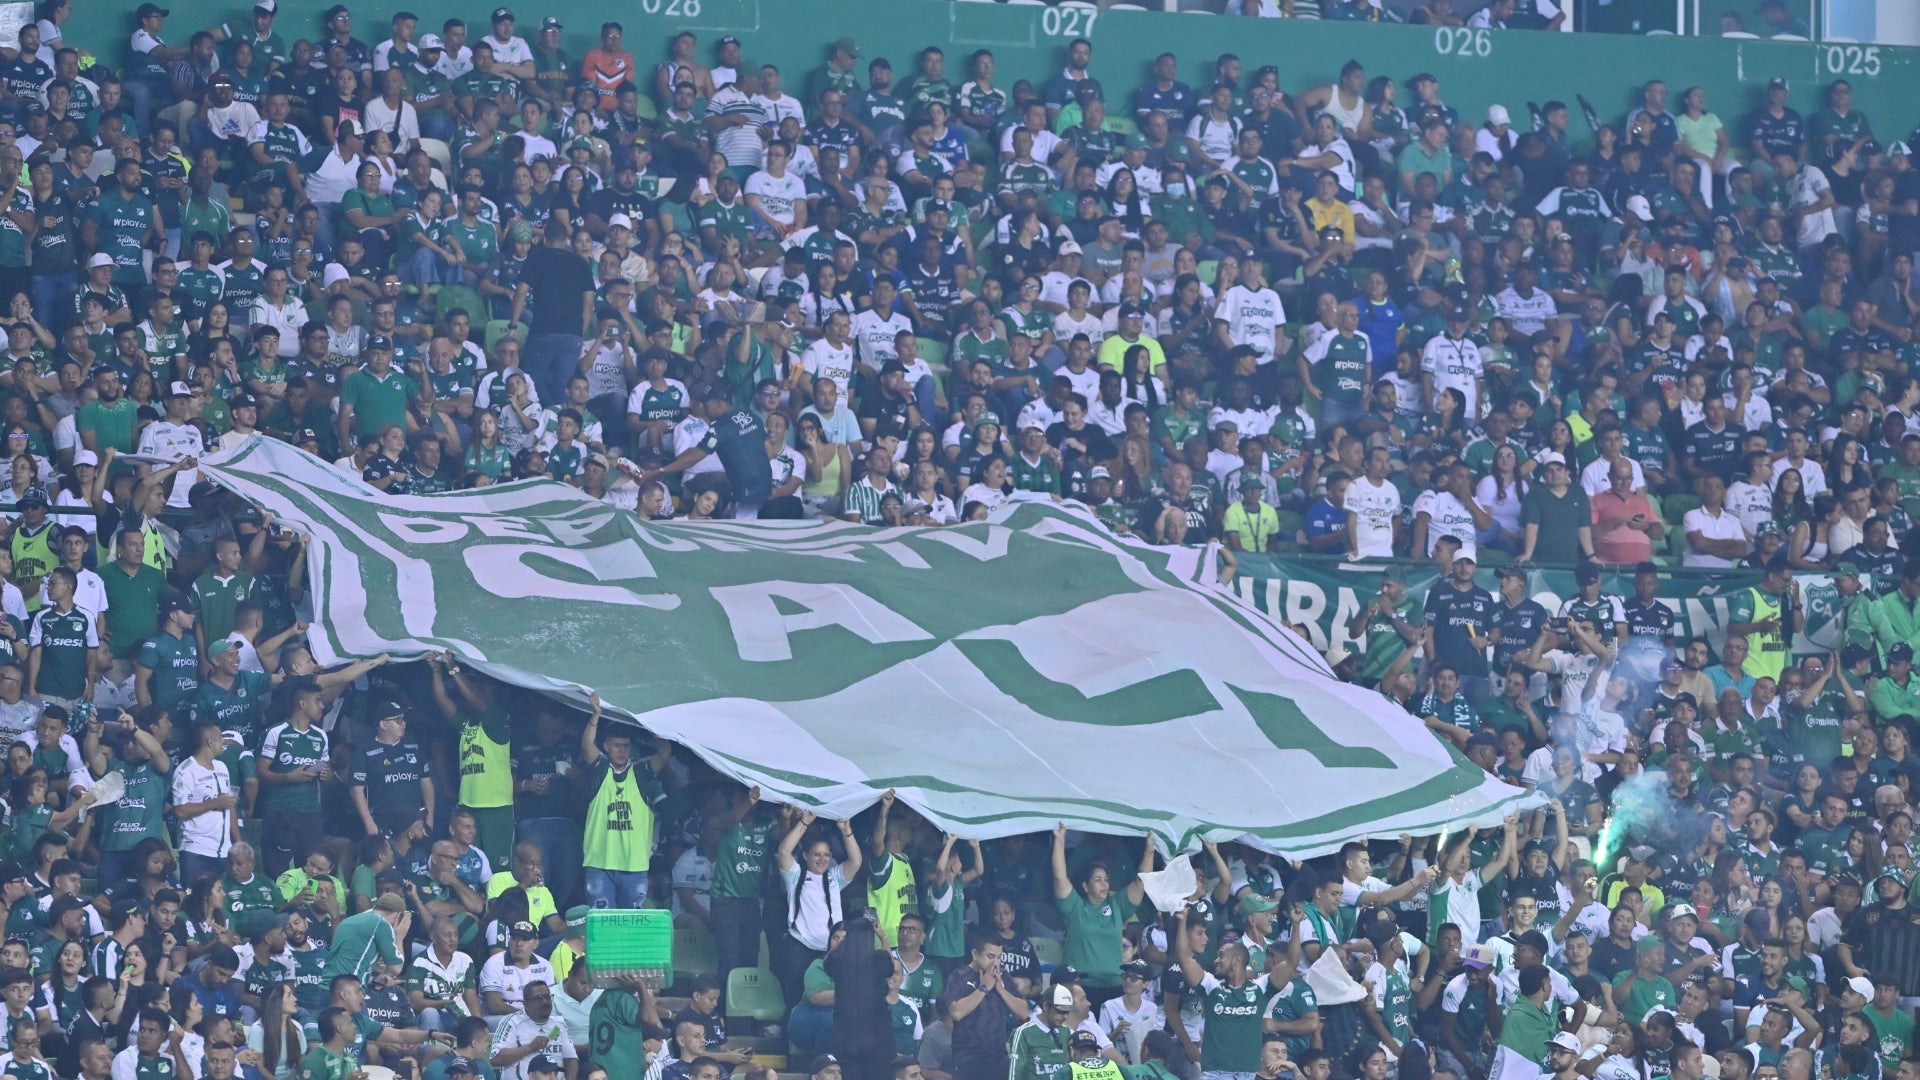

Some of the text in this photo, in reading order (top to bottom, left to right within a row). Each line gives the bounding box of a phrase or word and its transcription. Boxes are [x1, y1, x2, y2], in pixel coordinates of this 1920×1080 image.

[1043, 7, 1098, 37] 027
[1435, 26, 1492, 57] 026
[1827, 46, 1881, 76] 025
[113, 218, 147, 229] Wplay.co
[1449, 617, 1482, 628] Wplay.co
[54, 638, 83, 648] siesa
[295, 757, 317, 766] sies
[384, 772, 419, 783] Wplay.co
[602, 915, 653, 927] PALETAS
[1223, 1003, 1257, 1015] siesa
